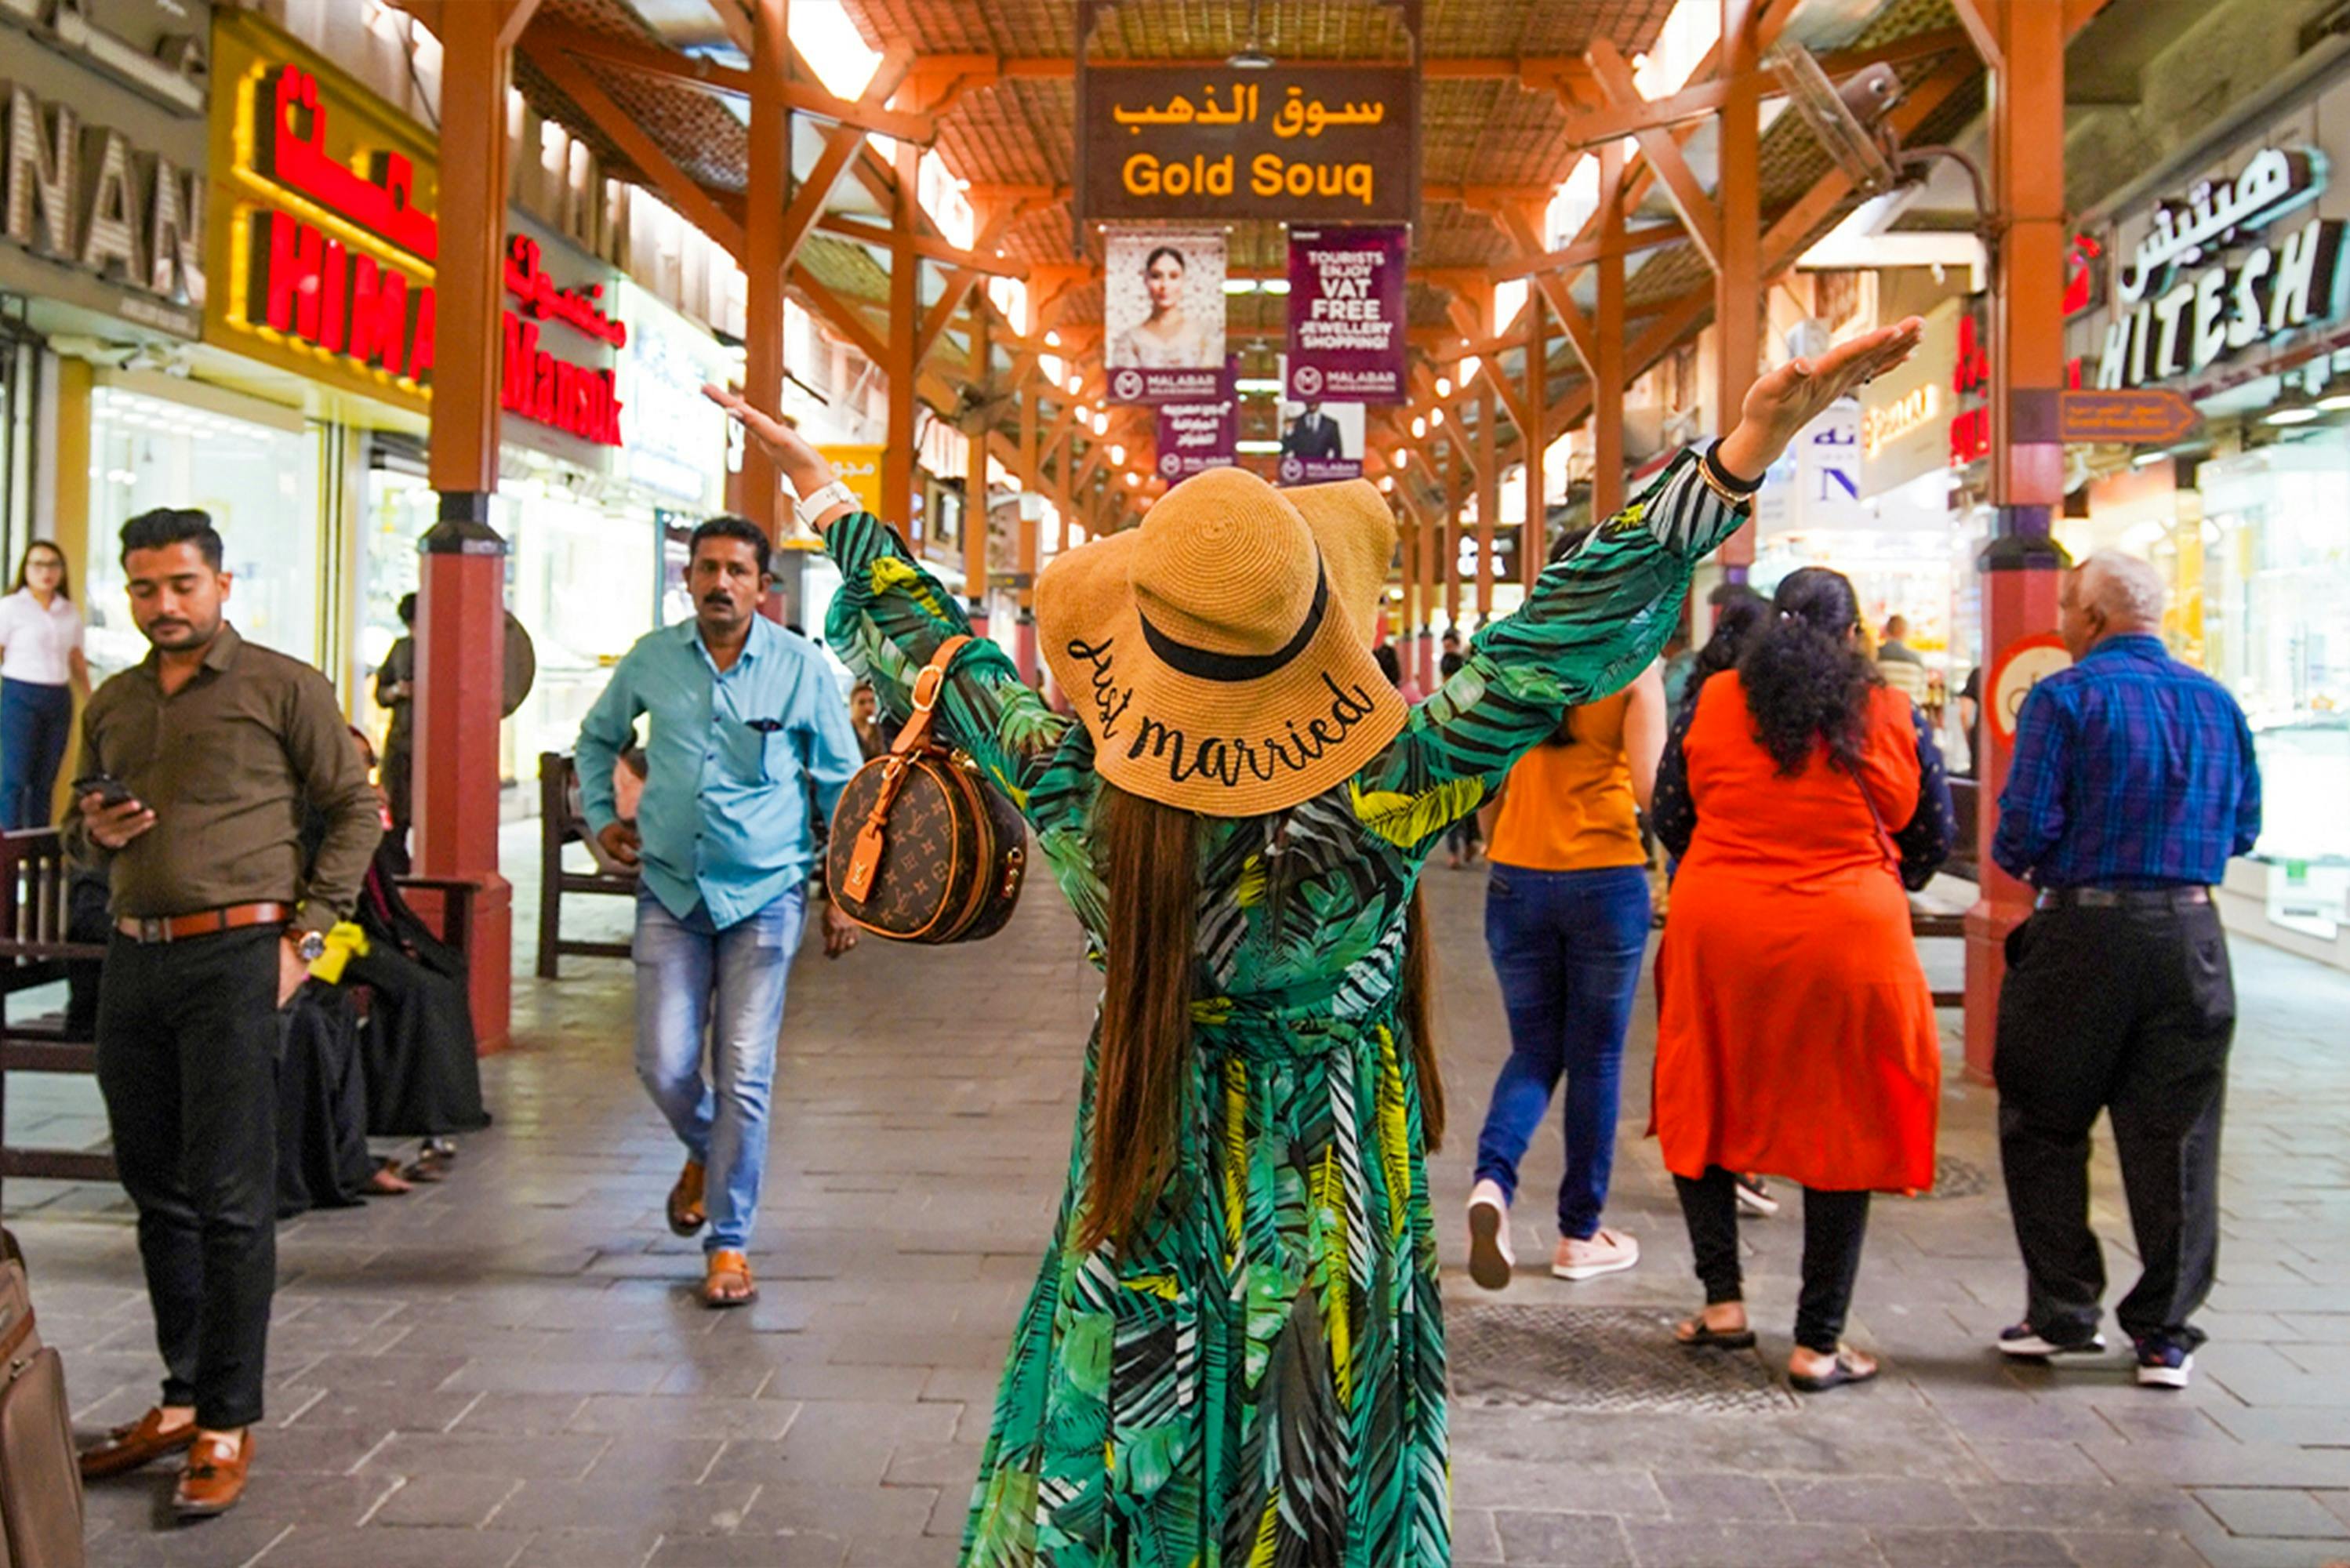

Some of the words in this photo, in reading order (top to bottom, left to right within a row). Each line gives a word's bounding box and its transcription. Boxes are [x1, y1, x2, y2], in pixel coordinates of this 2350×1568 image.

[1113, 82, 1259, 135] الذهب
[1272, 85, 1385, 138] سوق
[1122, 152, 1234, 197] Gold
[1250, 152, 1374, 206] Souq
[1307, 250, 1386, 266] TOURISTS
[1320, 264, 1372, 278] ENJOY
[1320, 278, 1372, 299] VAT
[1311, 299, 1381, 320] FREE
[2097, 218, 2322, 390] HITESH
[1298, 321, 1393, 335] JEWELLERY
[1147, 373, 1216, 386] MALABAR
[1327, 371, 1397, 383] MALABAR
[1819, 467, 1858, 501] N
[1066, 637, 1134, 741] Just
[1127, 671, 1375, 787] married
